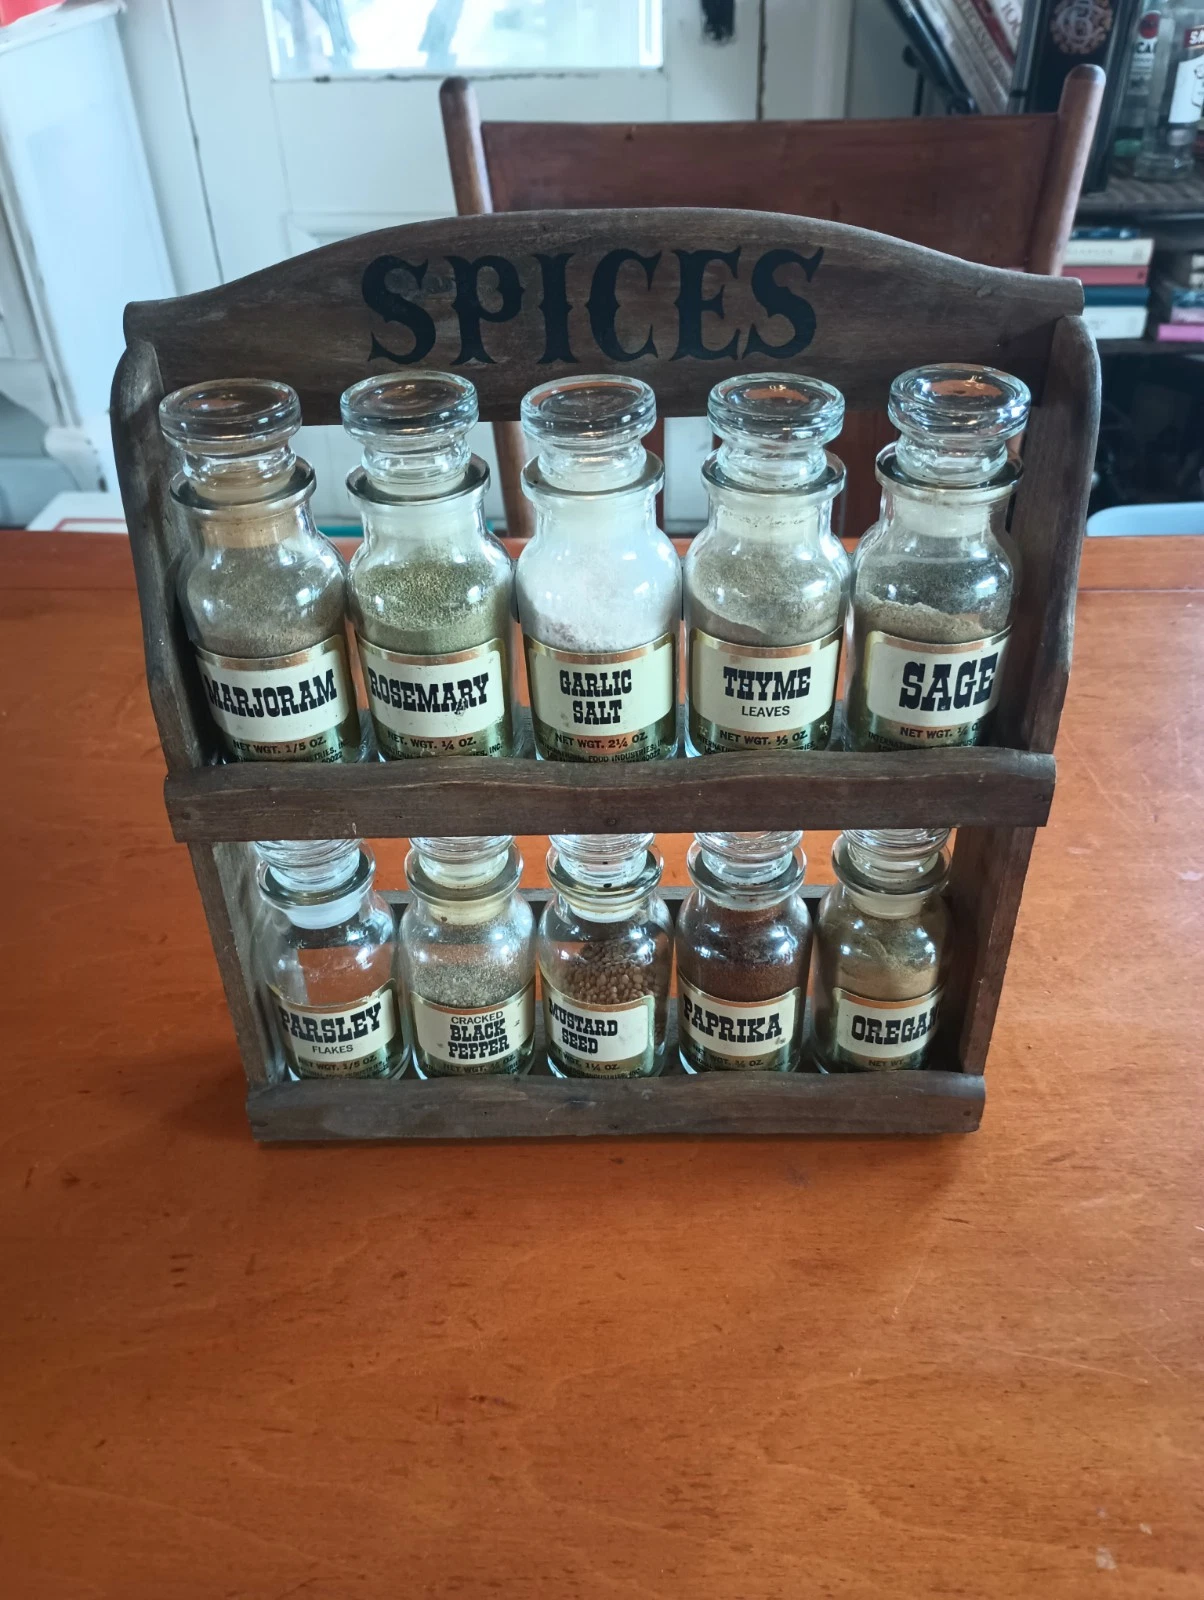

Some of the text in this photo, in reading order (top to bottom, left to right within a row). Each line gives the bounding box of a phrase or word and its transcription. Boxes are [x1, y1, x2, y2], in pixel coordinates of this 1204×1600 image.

[361, 246, 824, 365] SPICES
[203, 668, 338, 718] MARJORAM
[367, 666, 489, 715] ROSEMARY
[560, 669, 632, 697] GARLIC
[723, 666, 811, 701] THYME
[899, 652, 998, 712] SAGE
[572, 699, 622, 725] SALT
[741, 705, 790, 717] LEAVES
[387, 730, 407, 745] NET.
[410, 741, 437, 749] WGT.
[458, 737, 477, 747] OZ.
[555, 732, 574, 746] NET
[577, 740, 605, 749] WGT.
[720, 729, 741, 742] NET
[744, 736, 771, 745] WGT.
[900, 727, 923, 738] NET
[926, 729, 953, 739] WGT.
[233, 739, 251, 751] NET
[254, 745, 281, 754] WGT.
[286, 742, 306, 754] 1/5
[278, 1001, 382, 1043] PARSLEY
[451, 1010, 504, 1025] CRACKED
[549, 997, 618, 1037] MUSTARD
[683, 993, 783, 1043] PAPRIKA
[450, 1018, 506, 1042] BLACK
[562, 1028, 599, 1054] SEED
[312, 1044, 354, 1054] FLAKES
[448, 1035, 510, 1060] PEPPER
[316, 1063, 340, 1071] WGT.
